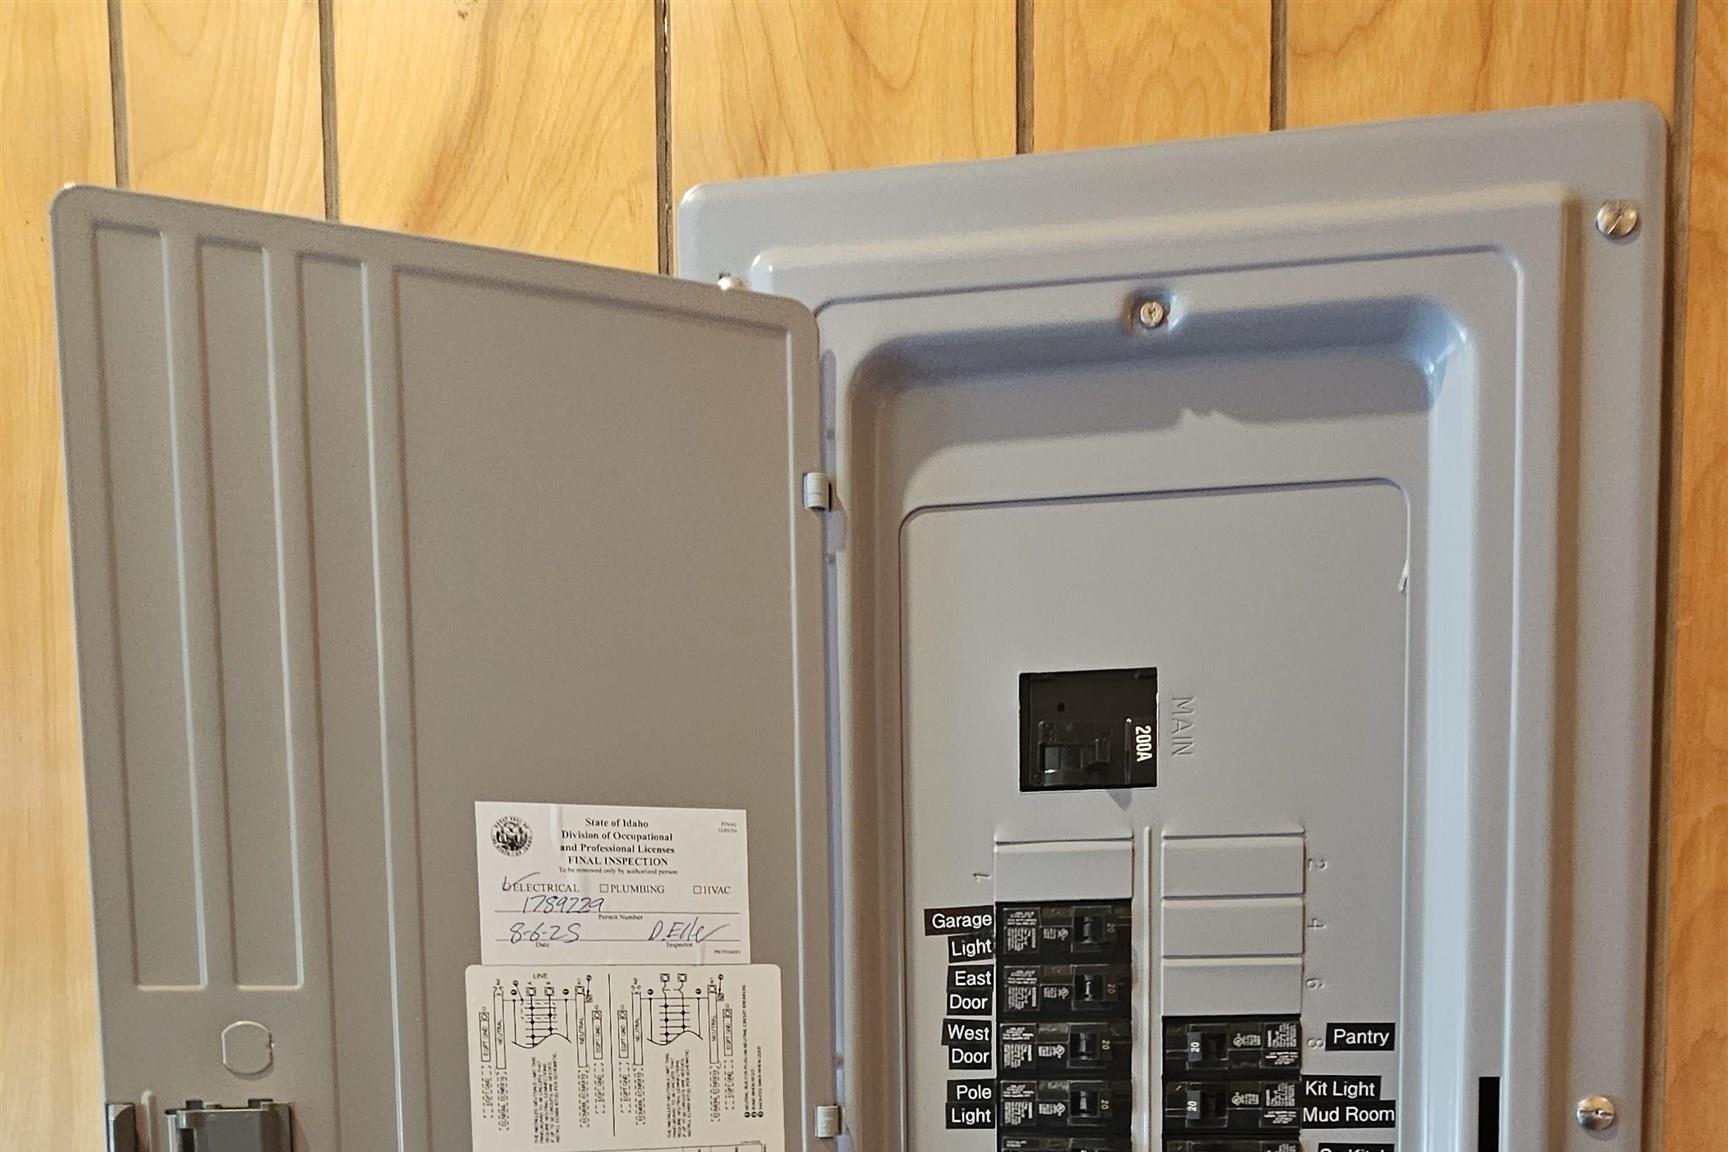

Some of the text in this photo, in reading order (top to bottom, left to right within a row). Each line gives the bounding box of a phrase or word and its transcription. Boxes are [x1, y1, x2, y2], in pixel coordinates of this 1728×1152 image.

[1171, 697, 1194, 756] MAIN
[1136, 725, 1152, 762] 200A
[585, 818, 648, 828] State of Idaho
[561, 830, 673, 842] Division of Occupational
[560, 843, 675, 853] and Professional Licenses
[568, 856, 668, 866] FINAL INSPECTION
[513, 883, 731, 894] ELECTRICAL PLUMBING HVAC
[932, 913, 992, 929] Garage
[1307, 918, 1326, 930] 4
[951, 939, 992, 958] Light
[955, 970, 992, 986] East
[1108, 983, 1116, 994] 20
[950, 994, 988, 1009] Door
[948, 1024, 990, 1040] West
[1334, 1029, 1389, 1046] Pantry
[1102, 1039, 1110, 1050] 20
[1191, 1042, 1200, 1052] 20
[951, 1048, 990, 1064] Door
[956, 1085, 992, 1100] Pole
[1305, 1081, 1375, 1098] Kit Light
[1101, 1100, 1109, 1110] 20
[1188, 1101, 1197, 1112] 20
[951, 1107, 991, 1125] Light
[1303, 1106, 1394, 1122] Mud Room
